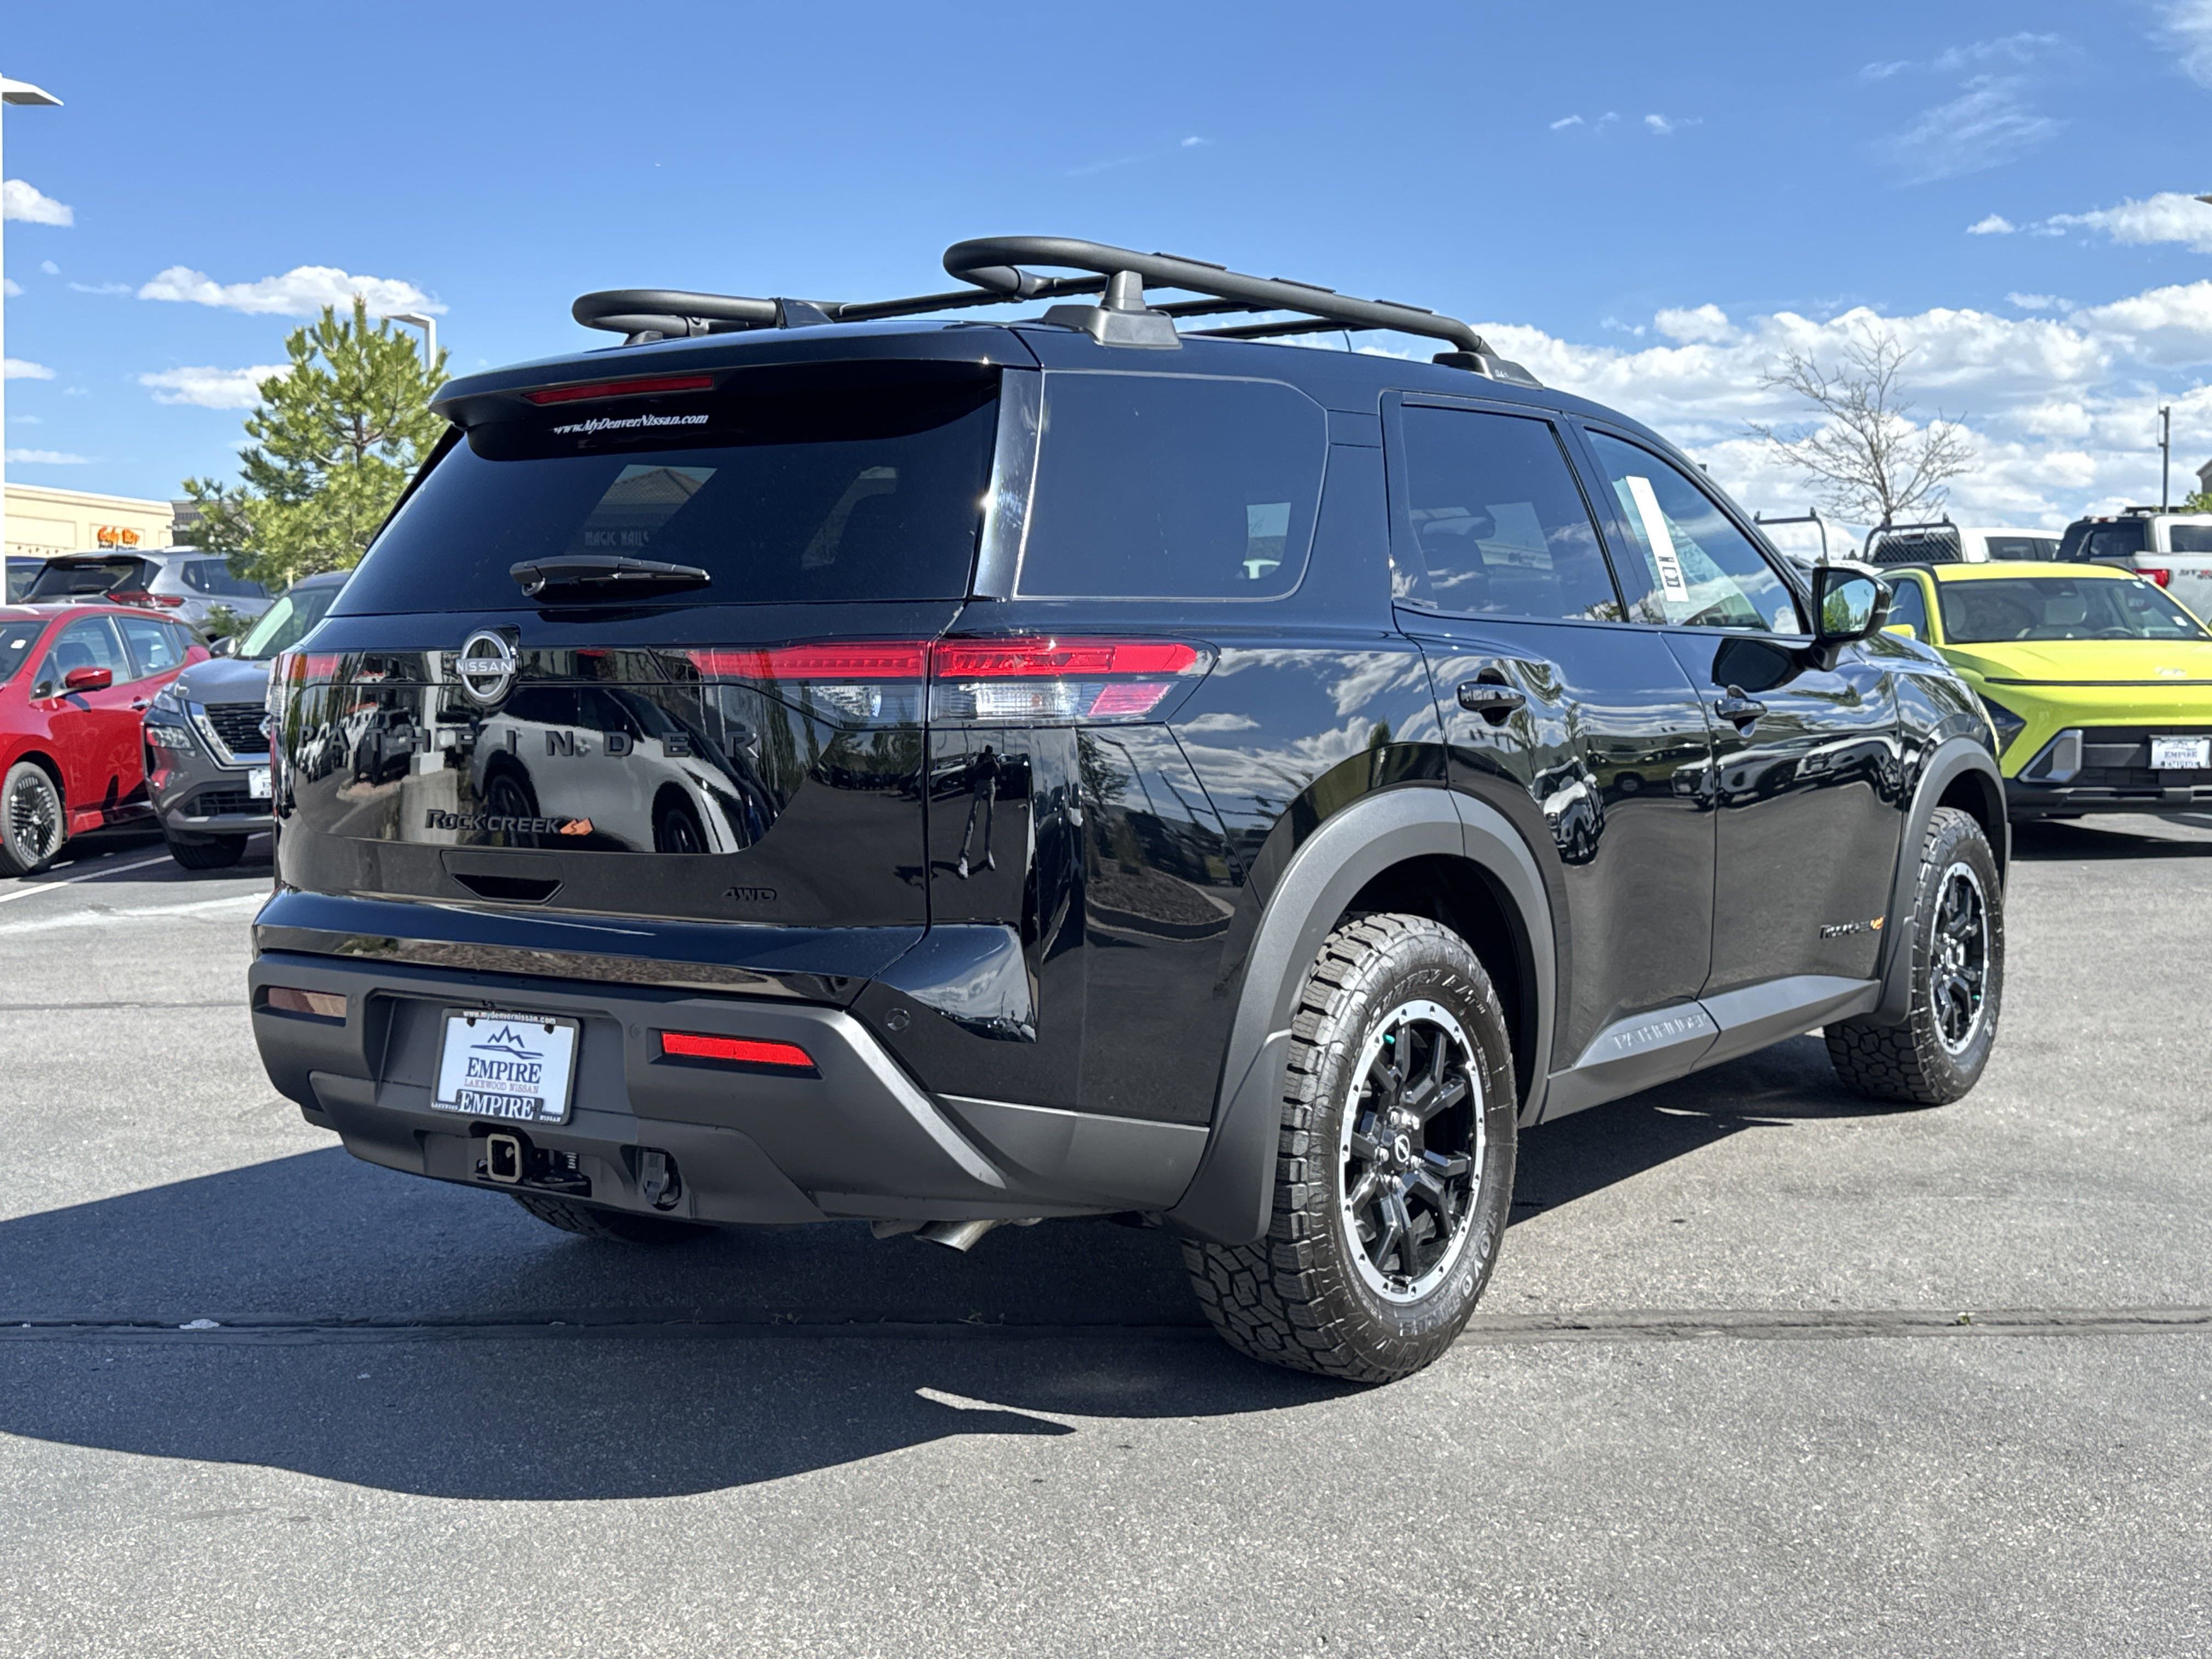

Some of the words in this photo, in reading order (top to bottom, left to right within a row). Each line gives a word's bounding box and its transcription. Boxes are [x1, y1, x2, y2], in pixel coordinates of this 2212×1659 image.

[554, 414, 709, 435] www.MyDenverNissan.com
[585, 531, 617, 546] MAGIC
[456, 661, 512, 672] NISSAN
[298, 725, 760, 759] PATHFINDER
[721, 887, 777, 901] 4WD
[465, 1057, 542, 1084] EMPIRE
[464, 1078, 507, 1091] LAKEWOOD
[509, 1083, 539, 1094] NISSAN
[458, 1091, 535, 1120] EMPIRE
